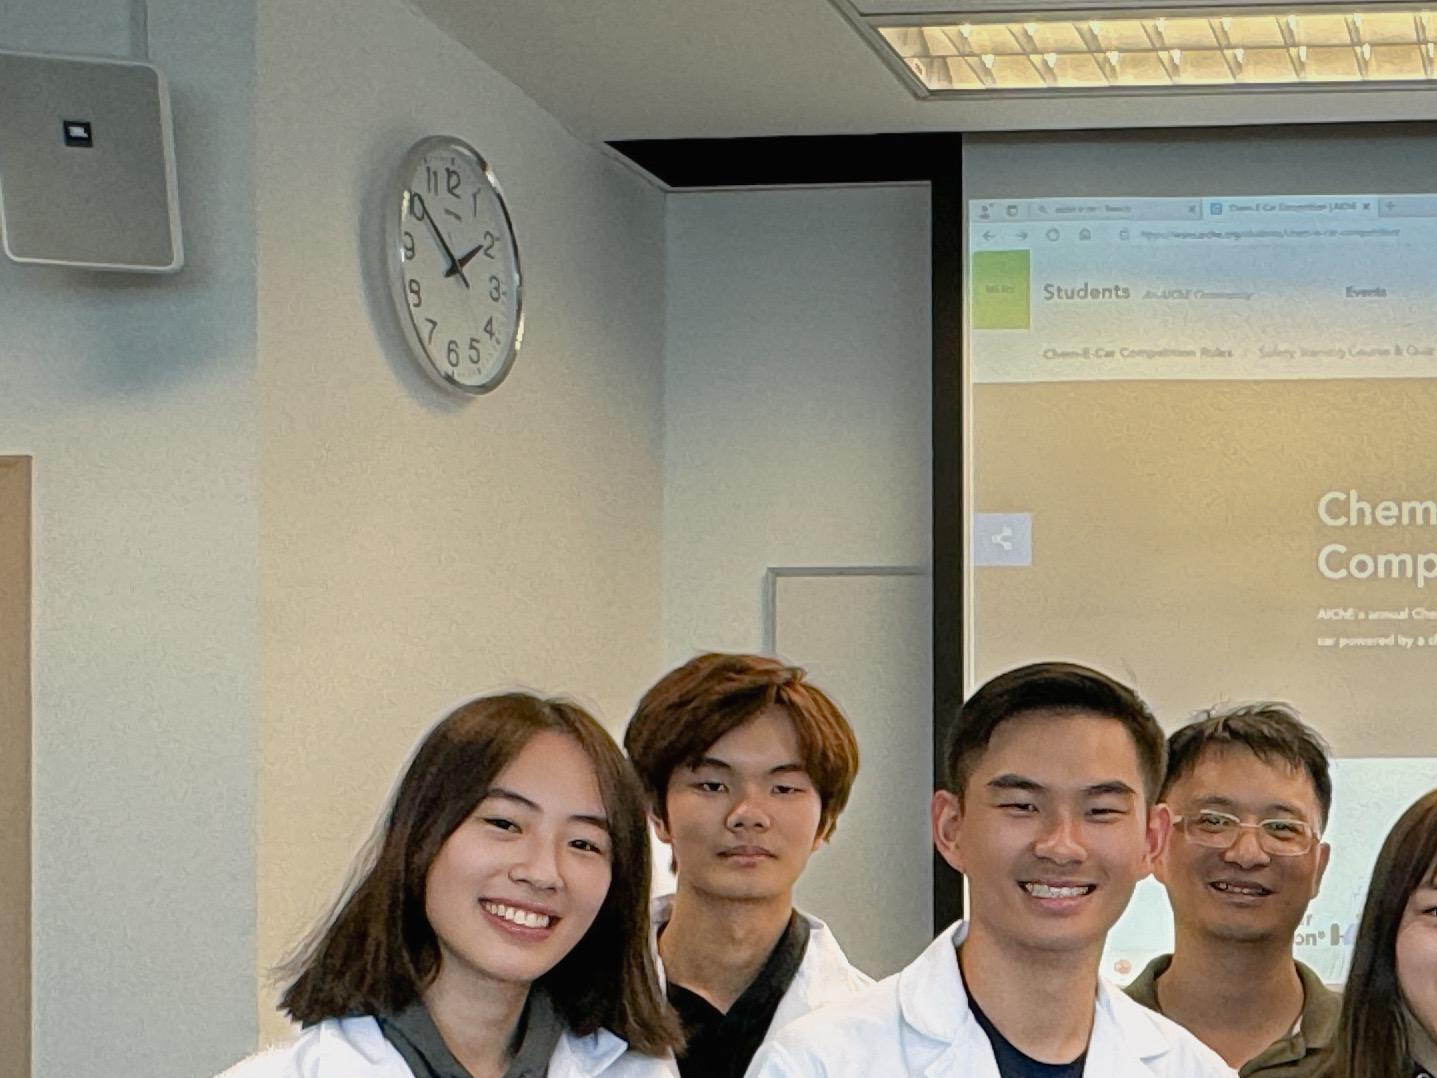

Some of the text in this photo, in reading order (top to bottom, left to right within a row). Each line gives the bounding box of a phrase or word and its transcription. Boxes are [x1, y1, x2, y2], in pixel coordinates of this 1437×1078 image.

[426, 166, 439, 196] 11
[446, 167, 461, 199] 12
[409, 190, 425, 221] 10
[472, 188, 480, 217] 1
[403, 231, 415, 260] 9
[483, 231, 495, 259] 2
[489, 276, 500, 302] 3
[1043, 282, 1130, 301] Students
[1345, 286, 1387, 298] Events
[425, 317, 438, 345] 7
[484, 316, 495, 341] 4
[447, 340, 460, 368] 6
[468, 337, 480, 365] 5
[1042, 347, 1115, 359] Chem-E-Car
[1120, 347, 1196, 360] Competition
[1368, 607, 1409, 620] annual
[1339, 633, 1394, 648] powered
[1398, 633, 1415, 648] by
[1416, 636, 1425, 647] a
